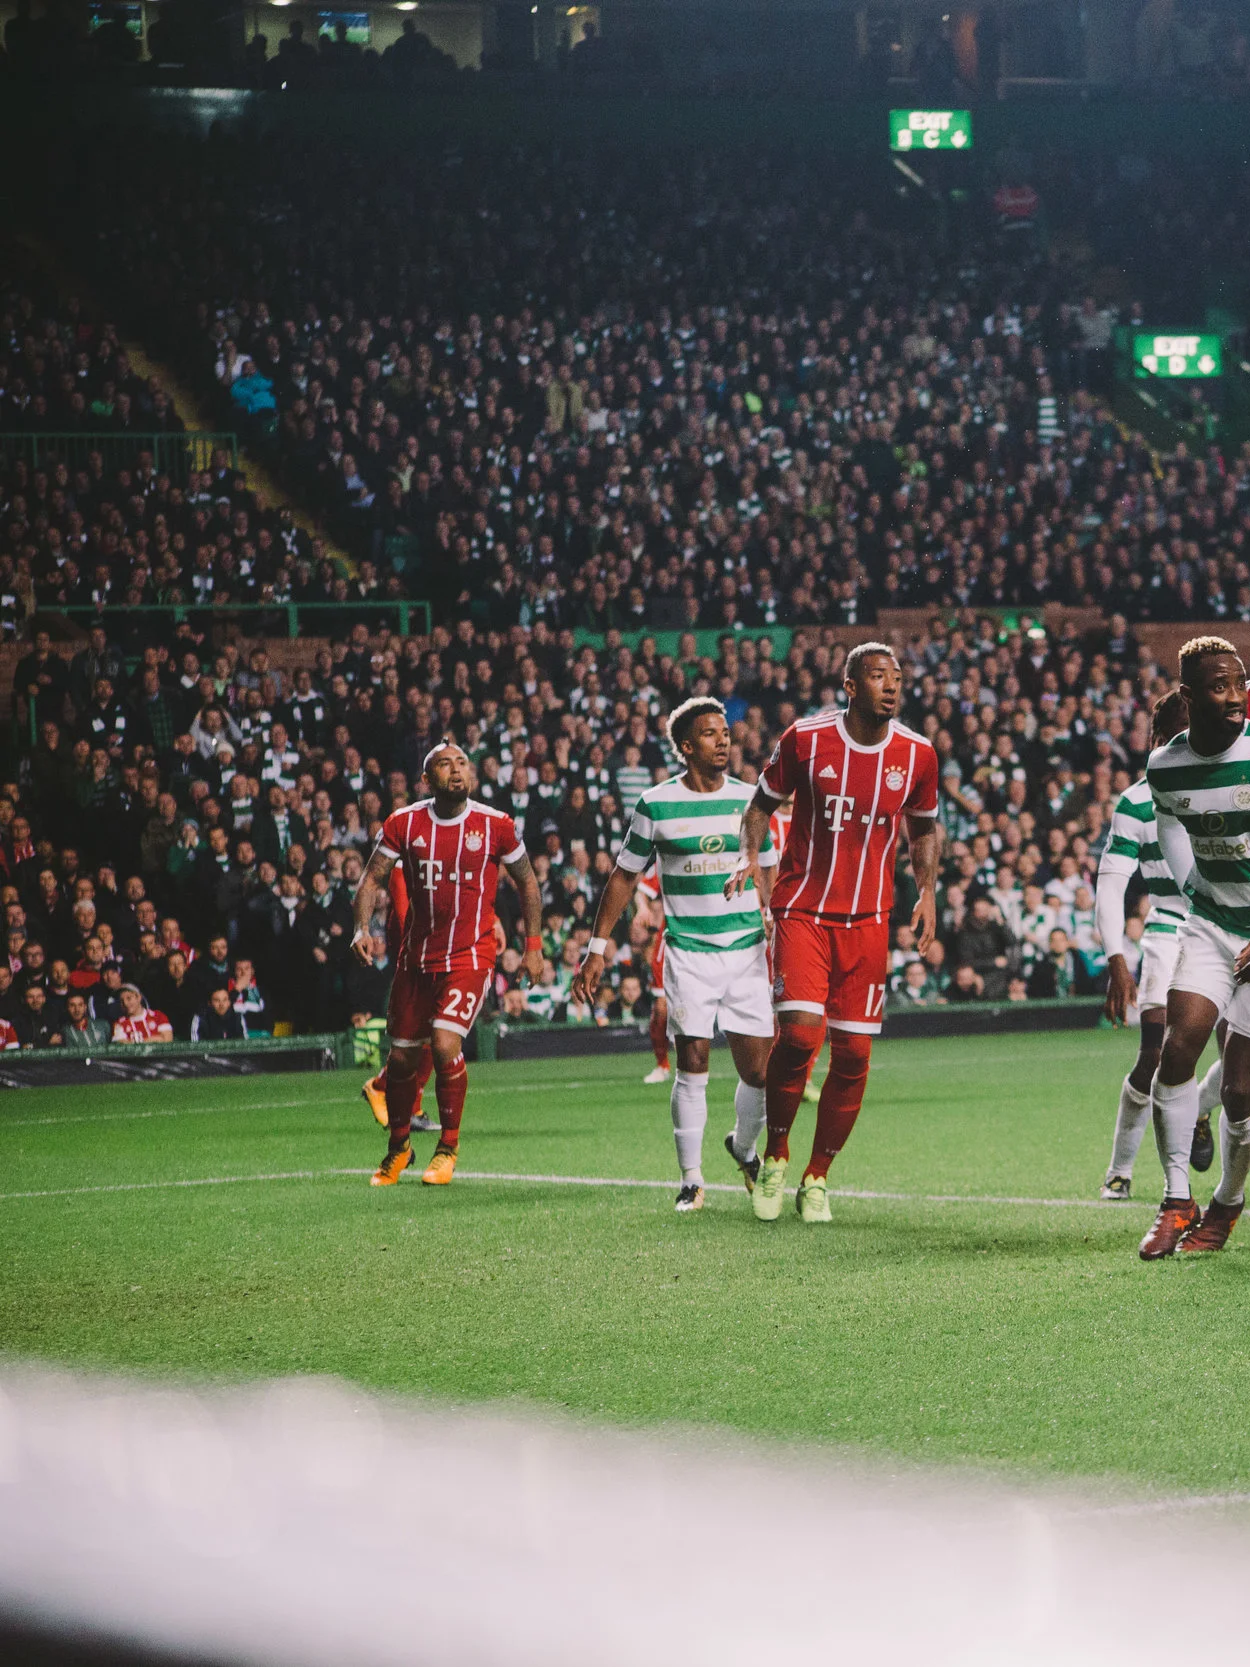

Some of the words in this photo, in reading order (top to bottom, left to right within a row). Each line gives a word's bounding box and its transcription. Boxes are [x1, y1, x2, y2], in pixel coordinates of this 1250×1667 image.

[909, 112, 953, 130] EXIT
[923, 130, 940, 148] C
[1154, 336, 1201, 356] EXIT
[1169, 356, 1186, 375] D
[442, 988, 476, 1020] 23
[865, 983, 886, 1017] 17
